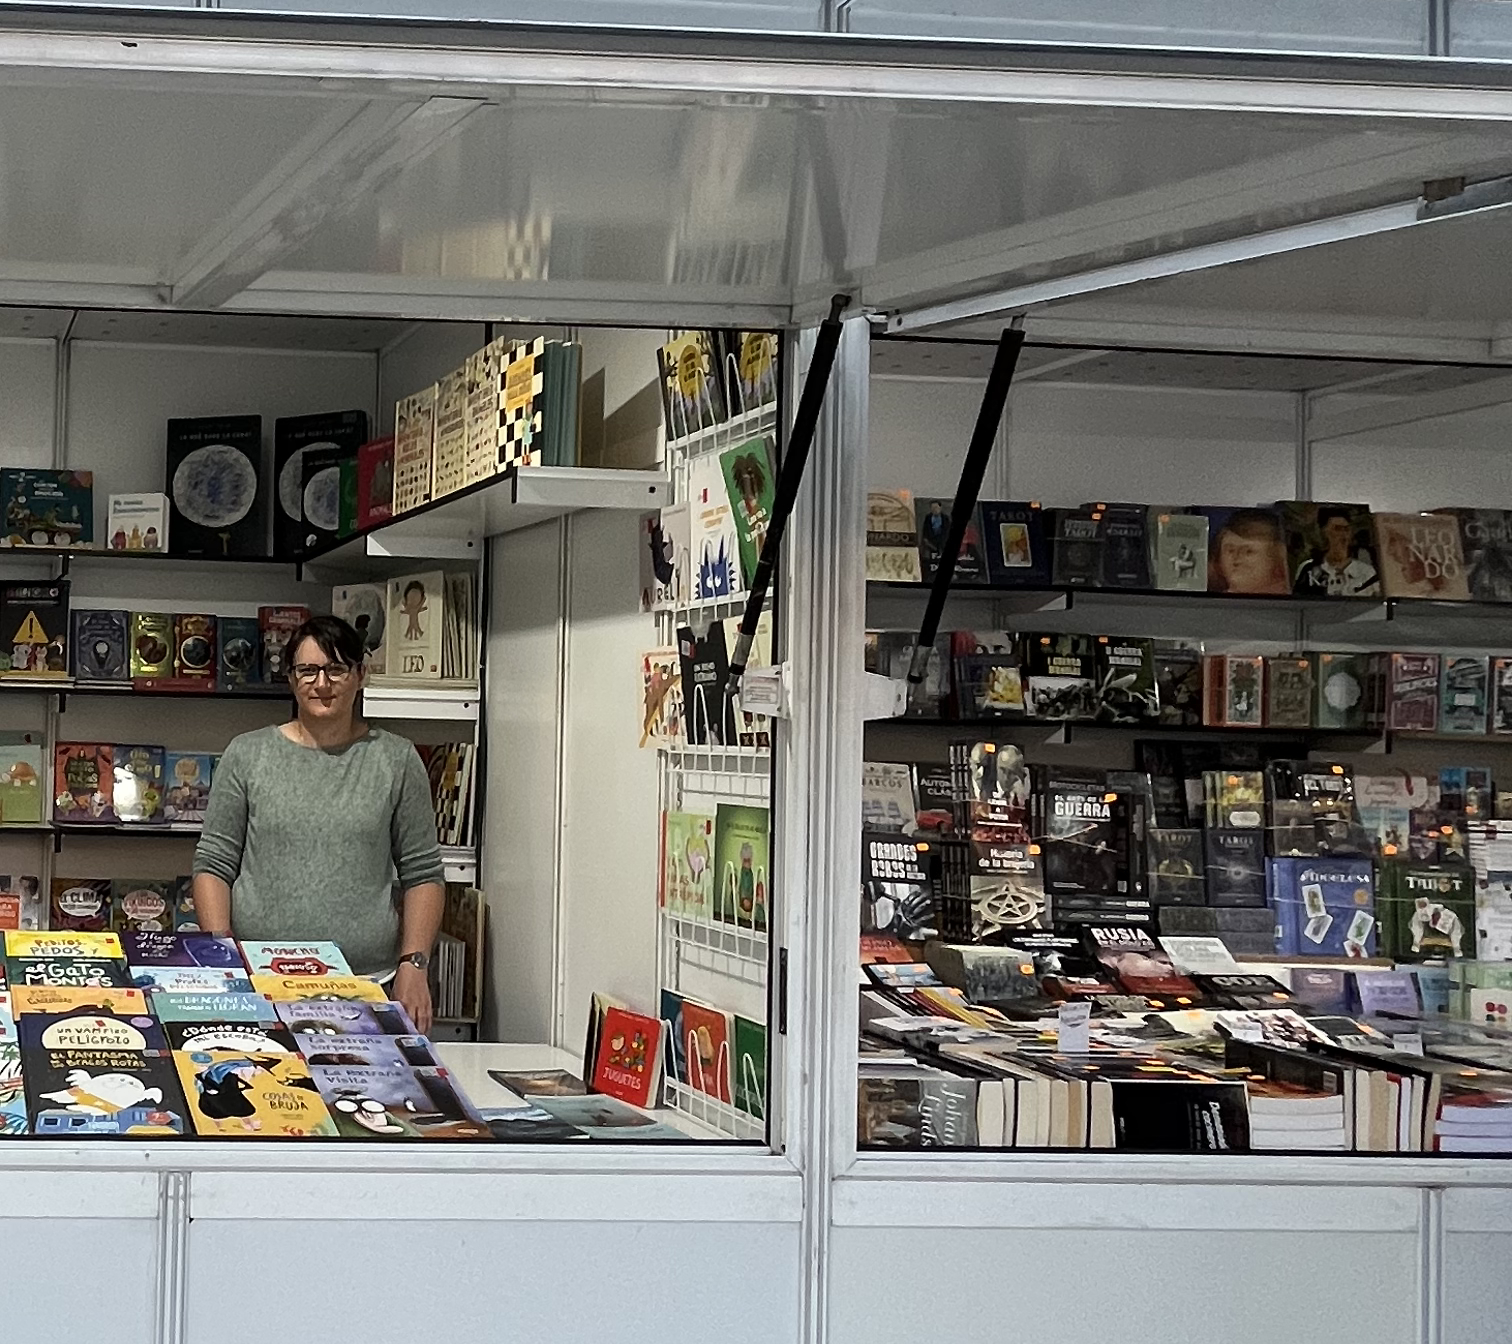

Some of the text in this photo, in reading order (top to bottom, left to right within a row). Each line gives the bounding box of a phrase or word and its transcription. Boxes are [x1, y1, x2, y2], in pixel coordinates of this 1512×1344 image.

[1054, 801, 1111, 818] GUERRA
[1090, 927, 1153, 941] RUSIA
[30, 946, 85, 955] PEDOS
[282, 980, 358, 990] Camuñas
[289, 1010, 336, 1018] familia
[308, 1036, 326, 1044] La
[310, 1043, 370, 1052] sorpresa
[323, 1068, 341, 1076] La
[601, 1065, 642, 1091] JUGUETES
[269, 1100, 309, 1111] BRUJA
